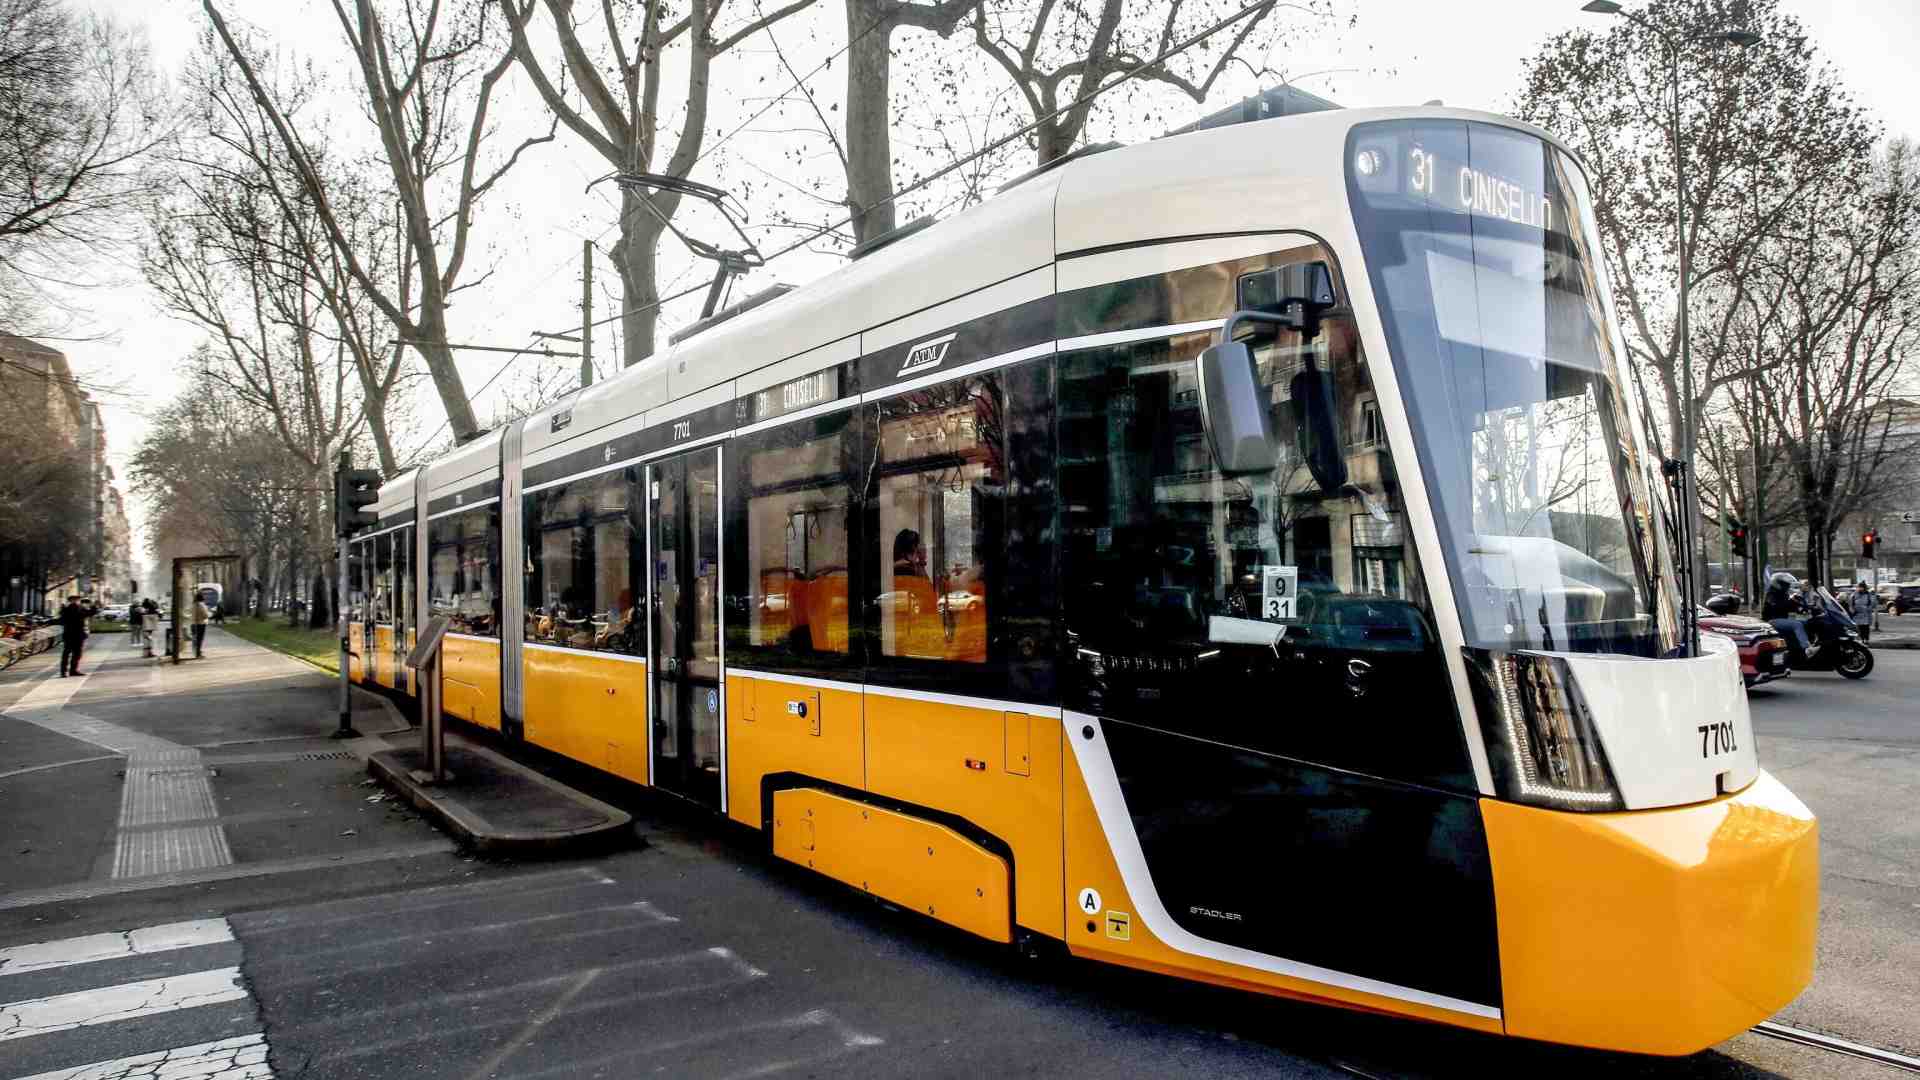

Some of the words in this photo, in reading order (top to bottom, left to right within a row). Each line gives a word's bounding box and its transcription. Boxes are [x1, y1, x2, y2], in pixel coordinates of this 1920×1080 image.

[1410, 147, 1434, 194] 31
[913, 345, 937, 365] ATM
[673, 419, 690, 441] 7701
[1275, 577, 1286, 596] 9
[1269, 600, 1289, 619] 31
[1698, 719, 1737, 758] 7701
[1085, 893, 1096, 910] A
[1190, 905, 1242, 921] STADLER
